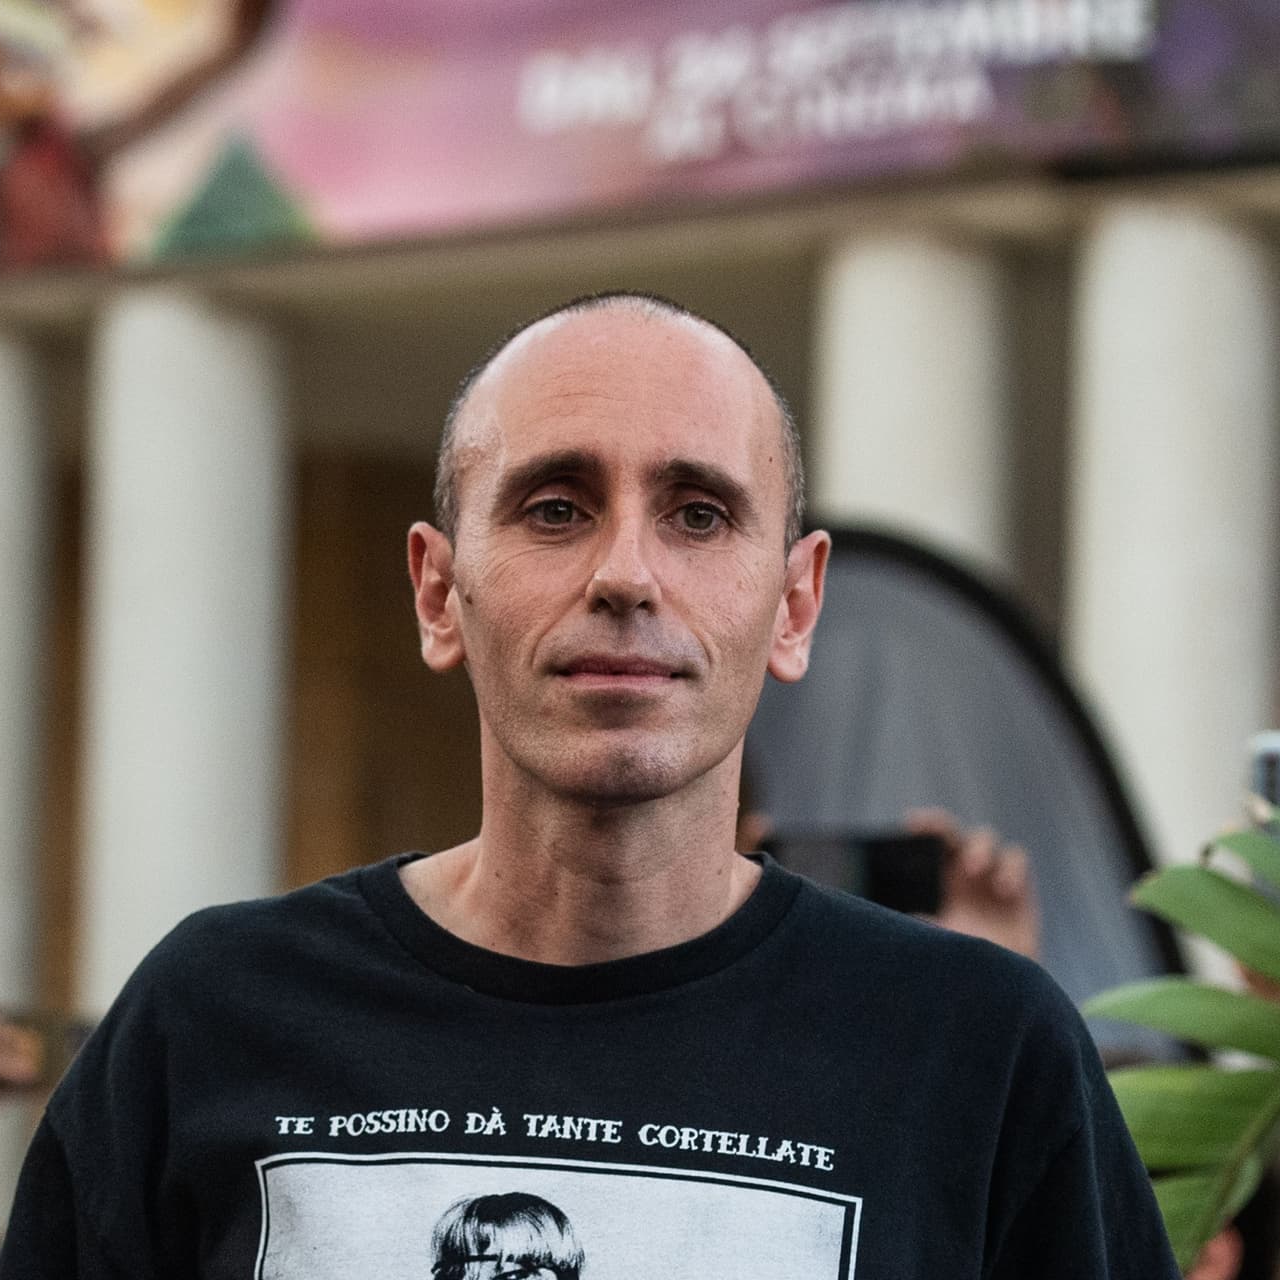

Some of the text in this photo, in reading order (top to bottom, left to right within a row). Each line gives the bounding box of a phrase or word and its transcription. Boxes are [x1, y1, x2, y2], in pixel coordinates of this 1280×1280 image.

[275, 1107, 835, 1172] TE POSSINO DÀ TANTE CORTELLATE
